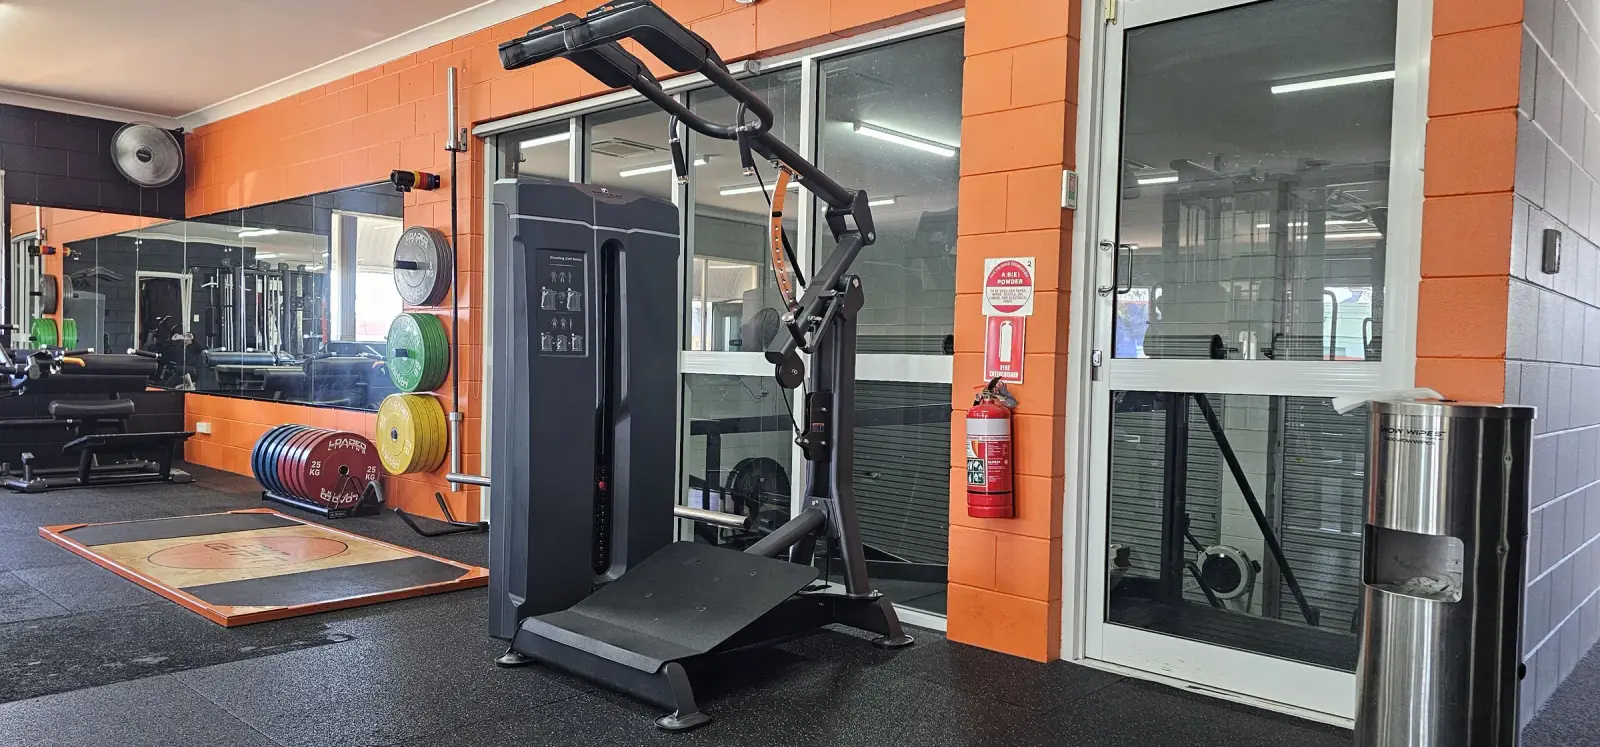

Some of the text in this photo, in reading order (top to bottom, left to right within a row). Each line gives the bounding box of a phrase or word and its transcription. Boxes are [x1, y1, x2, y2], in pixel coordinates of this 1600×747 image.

[1027, 260, 1032, 268] 2
[1000, 364, 1011, 372] FIRE
[1407, 429, 1446, 437] WIPES
[328, 438, 367, 451] LOADED
[327, 444, 366, 454] LIFTING
[311, 461, 321, 469] 25
